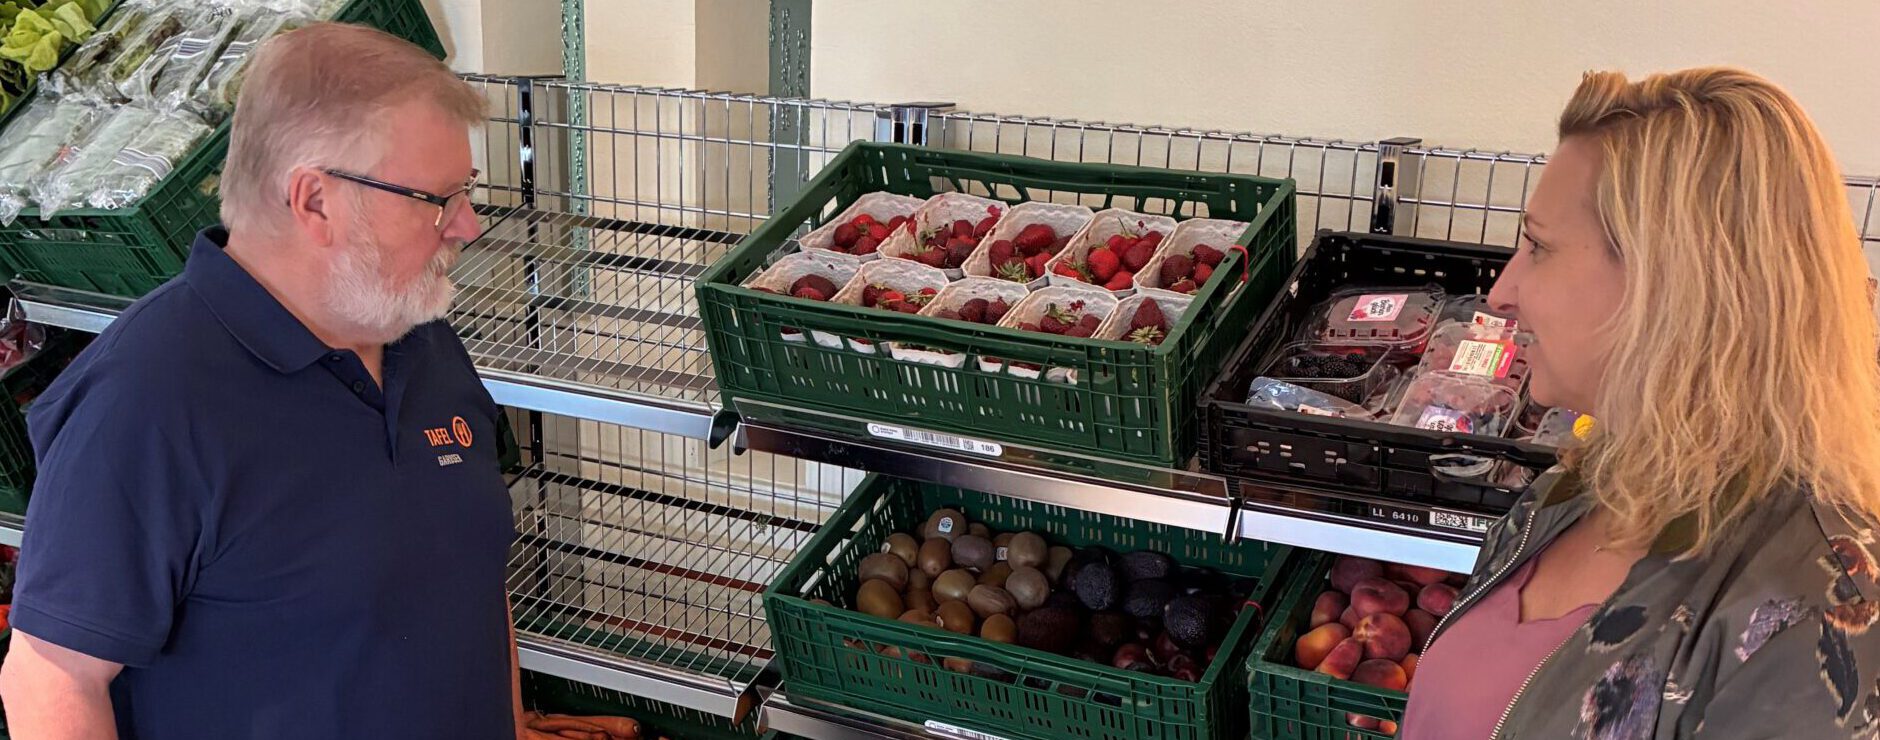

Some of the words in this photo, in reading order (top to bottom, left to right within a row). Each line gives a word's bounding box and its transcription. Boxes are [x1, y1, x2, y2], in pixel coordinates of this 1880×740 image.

[424, 427, 454, 447] TAFEL
[980, 443, 995, 453] 186
[1372, 507, 1385, 518] LL
[1392, 511, 1419, 523] 6410
